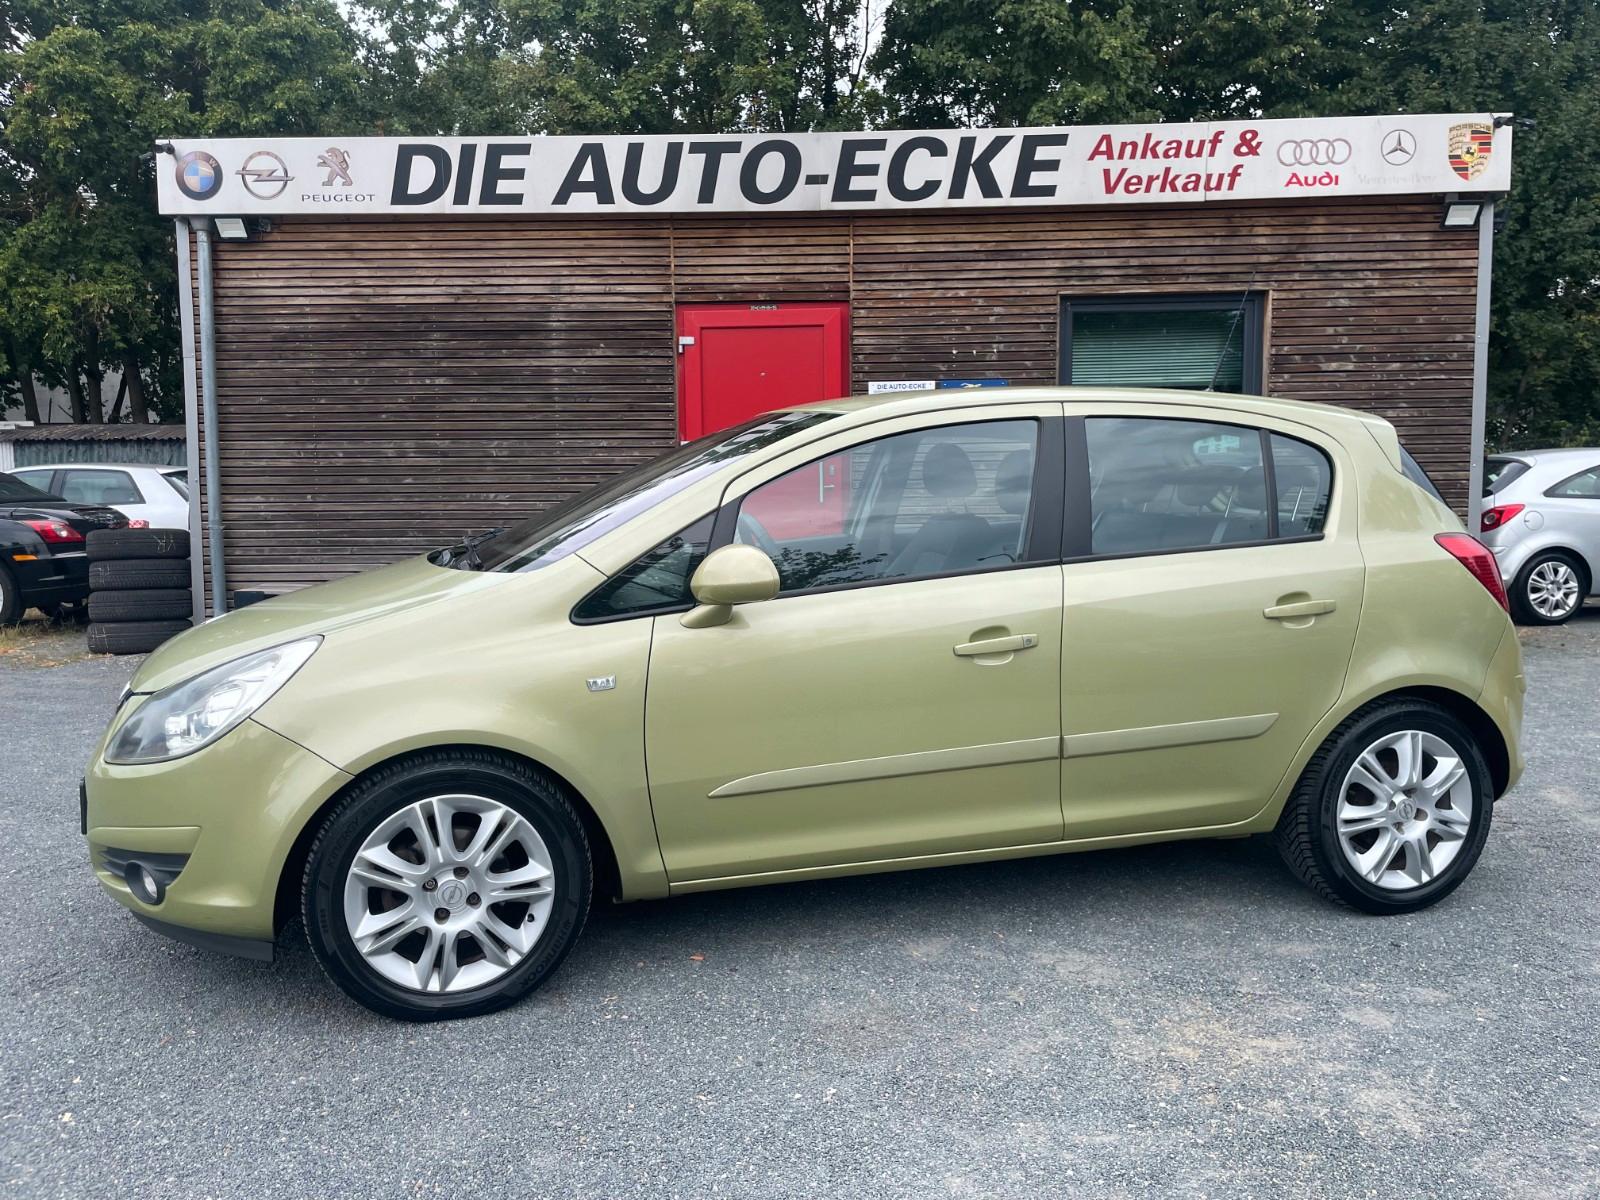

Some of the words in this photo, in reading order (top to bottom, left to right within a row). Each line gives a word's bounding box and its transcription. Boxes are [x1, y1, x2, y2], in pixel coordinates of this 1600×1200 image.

[1088, 130, 1223, 161] Ankauf
[1233, 129, 1262, 157] &
[390, 144, 531, 206] DIE
[551, 134, 1070, 206] AUTO-ECKE
[1103, 165, 1244, 196] Verkauf
[1284, 171, 1340, 188] Audi
[301, 193, 376, 203] PEUGEOT
[876, 383, 888, 391] DIE
